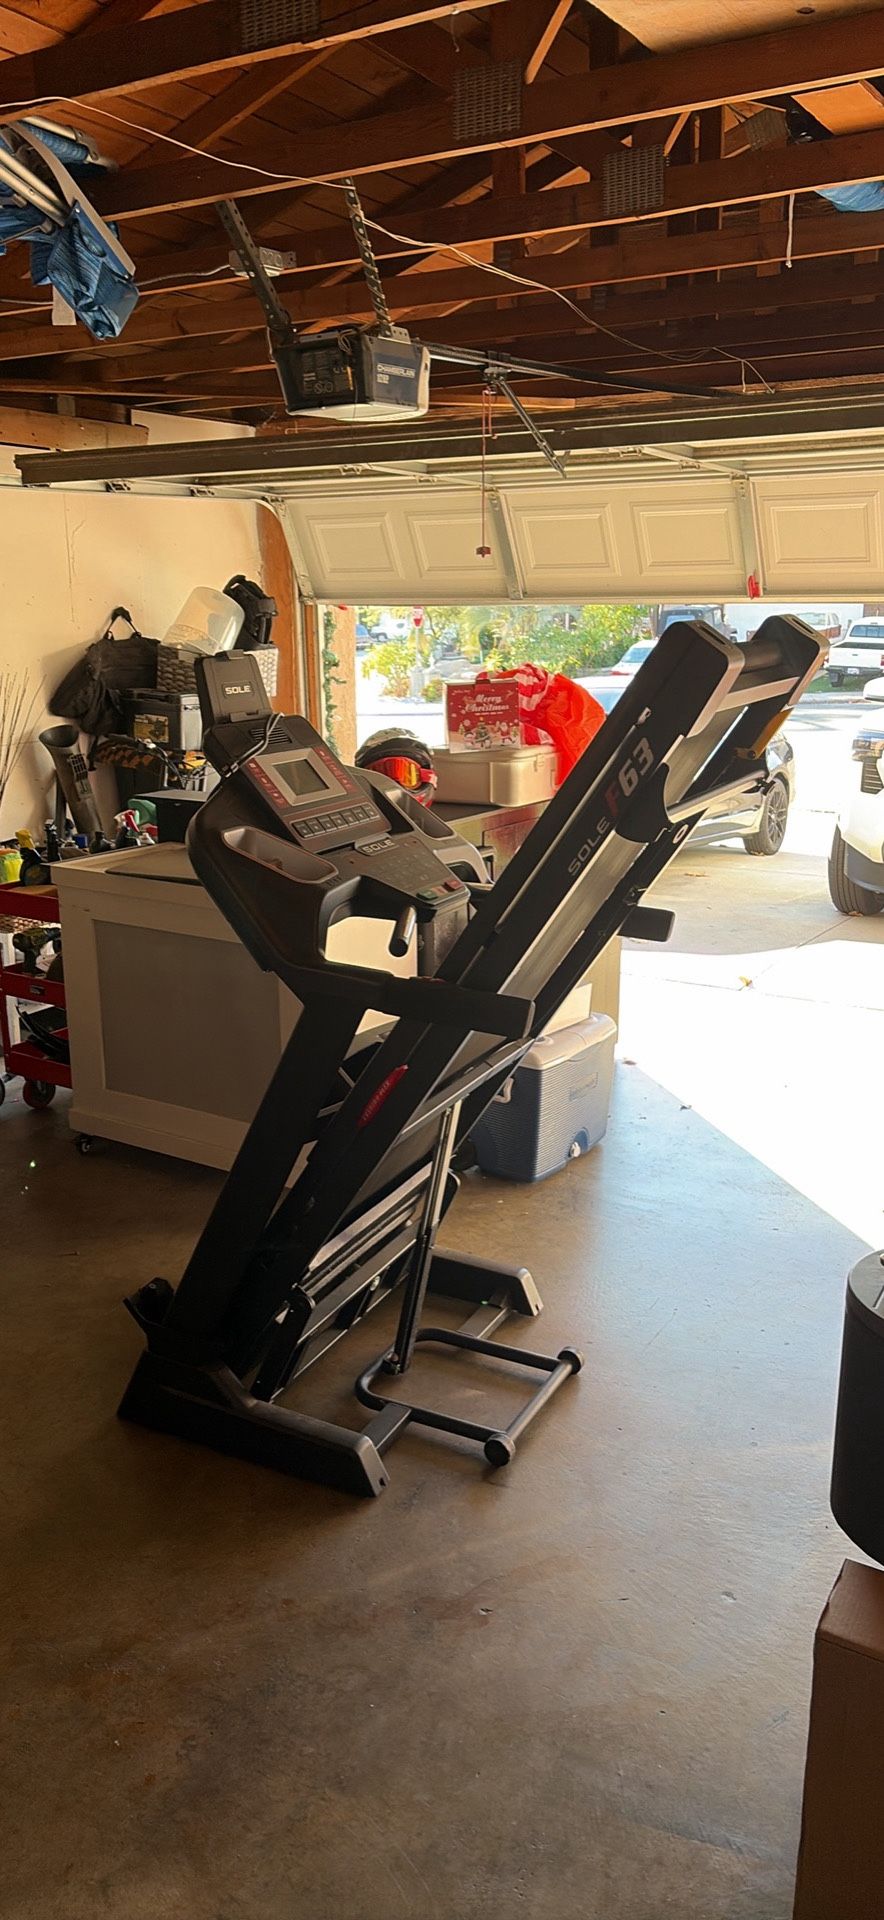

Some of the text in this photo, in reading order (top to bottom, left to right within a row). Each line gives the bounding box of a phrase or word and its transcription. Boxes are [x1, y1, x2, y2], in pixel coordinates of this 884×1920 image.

[225, 685, 251, 695] SOLE
[475, 694, 502, 704] Merry
[465, 703, 510, 712] Christmas
[567, 737, 655, 876] SOLE F63
[361, 839, 395, 853] SOLE
